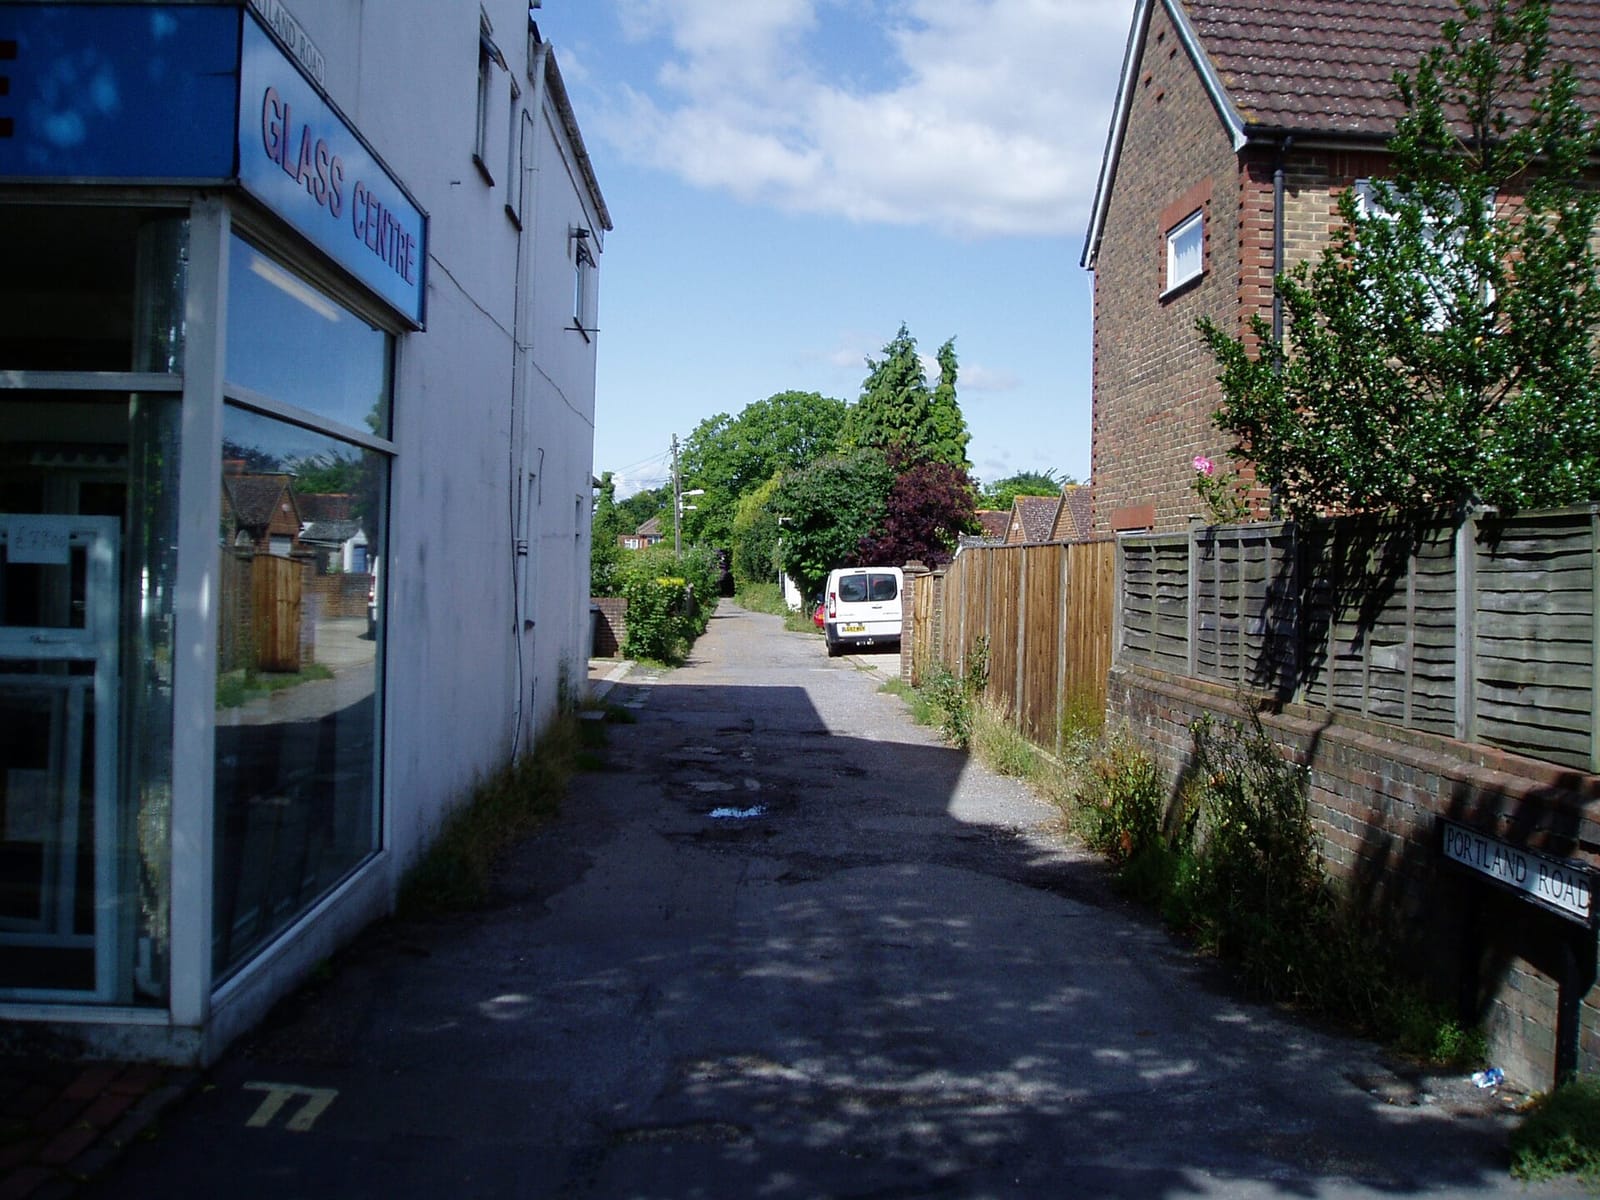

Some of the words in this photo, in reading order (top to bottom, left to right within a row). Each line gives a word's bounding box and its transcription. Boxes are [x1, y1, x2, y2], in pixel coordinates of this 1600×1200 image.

[300, 35, 323, 82] ROAD
[262, 86, 344, 220] GLASS
[353, 180, 415, 287] CENTRE
[1447, 828, 1527, 884] PORTLAND
[1538, 864, 1591, 910] ROAD
